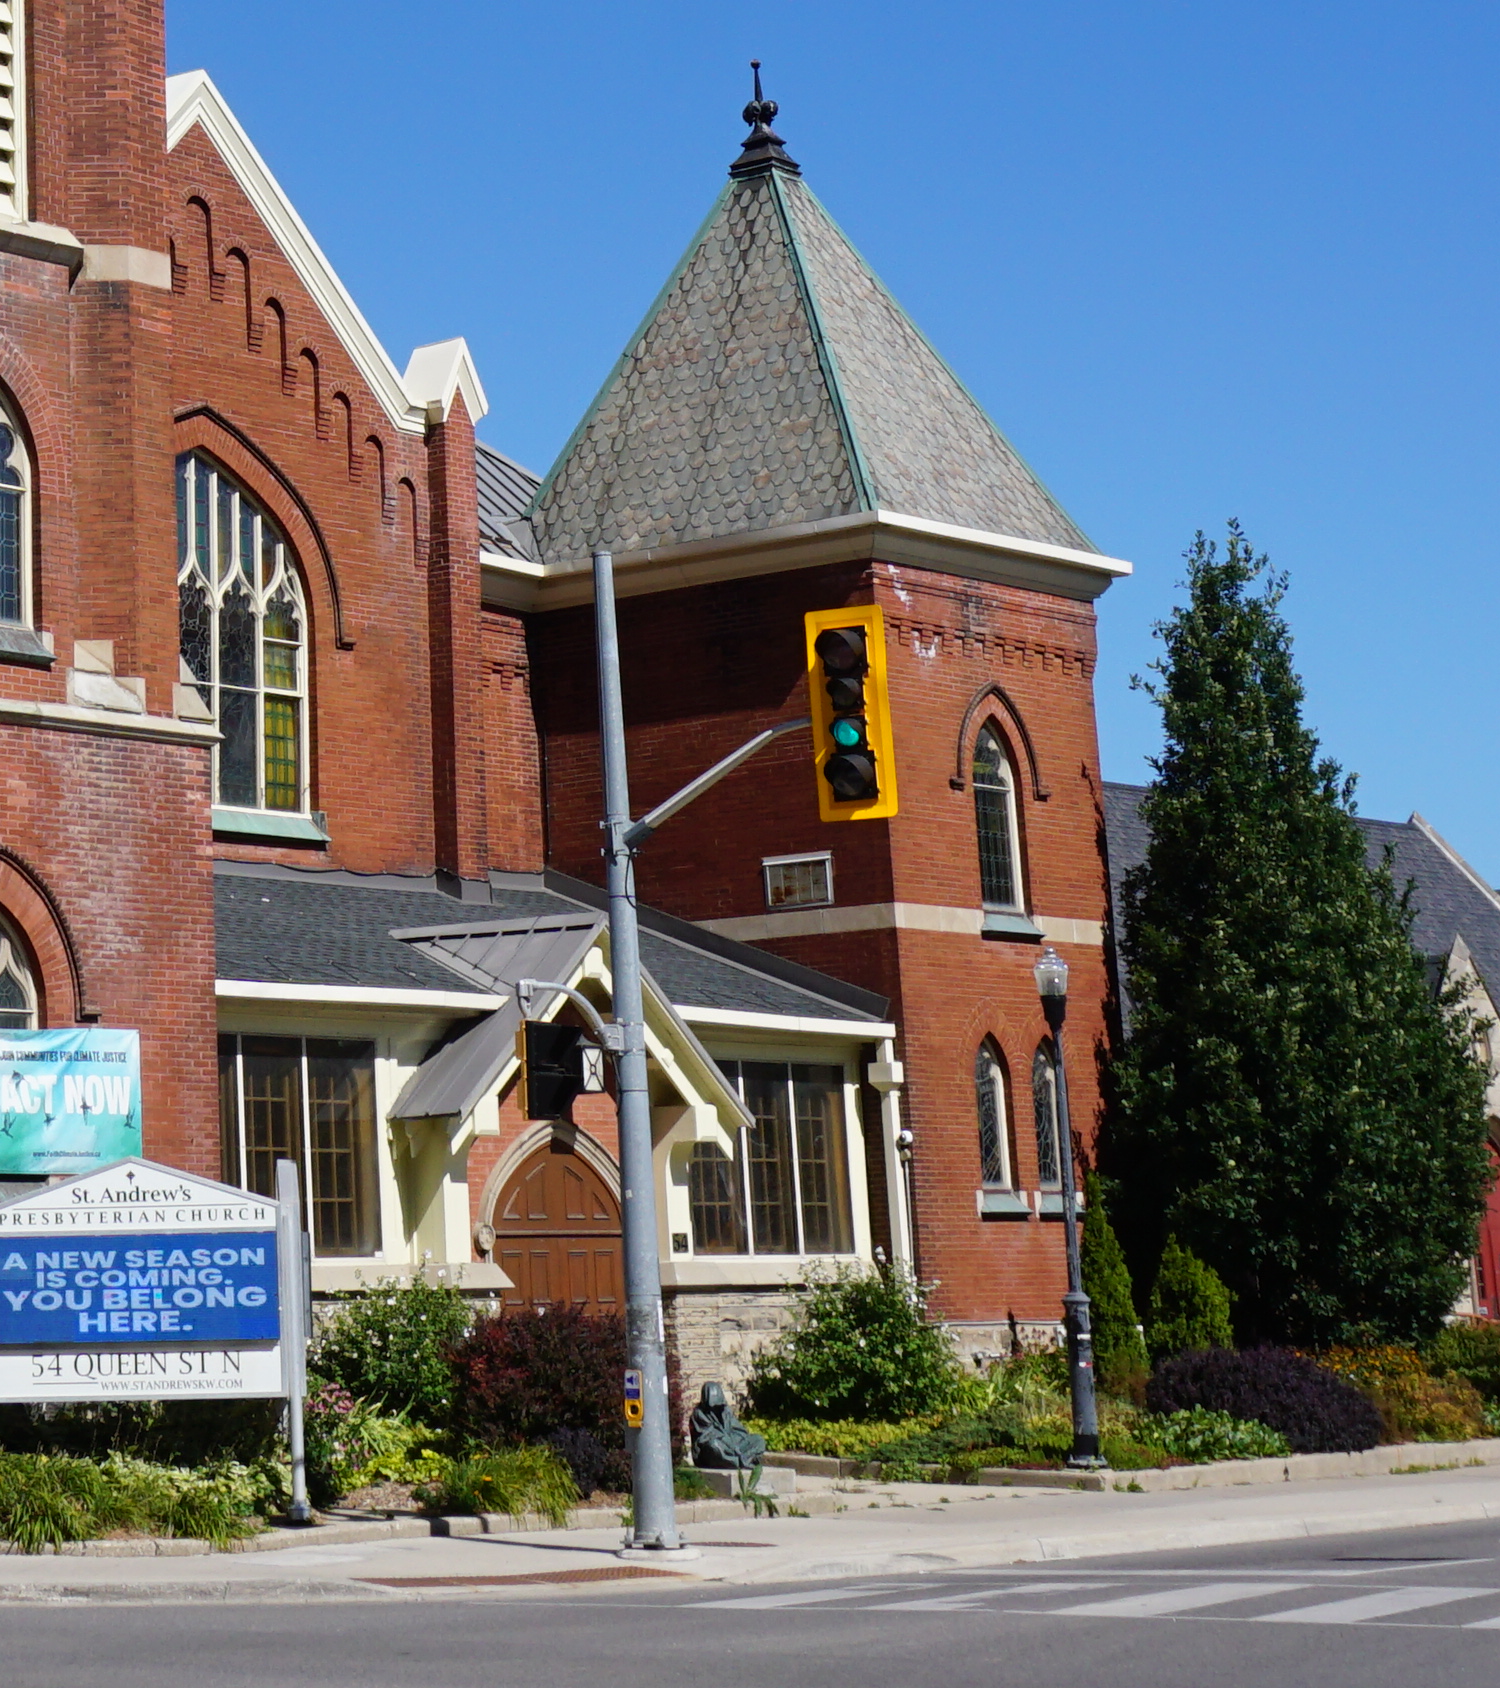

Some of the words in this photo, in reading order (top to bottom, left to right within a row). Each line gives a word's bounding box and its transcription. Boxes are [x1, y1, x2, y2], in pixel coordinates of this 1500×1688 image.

[0, 1050, 15, 1061] JOIN
[74, 1051, 100, 1063] CLIMATE
[102, 1051, 127, 1063] JUSTICE
[1, 1074, 58, 1114] ACT
[64, 1075, 132, 1115] NOW
[71, 1187, 95, 1204] St.
[100, 1184, 191, 1203] Andrew's
[176, 1208, 266, 1222] CHURCH
[2, 1252, 28, 1270] A
[36, 1250, 117, 1269] NEW
[124, 1247, 265, 1268] SEASON
[36, 1270, 67, 1288] IS
[75, 1268, 234, 1288] COMING.
[2, 1289, 92, 1311] YOU
[102, 1286, 267, 1310] BELONG
[78, 1310, 194, 1333] HERE.
[32, 1354, 62, 1377] 54
[73, 1352, 168, 1380] QUEEN
[179, 1350, 212, 1375] ST
[222, 1350, 241, 1373] N
[100, 1379, 244, 1391] WWW.STANDREWSKW.COM
